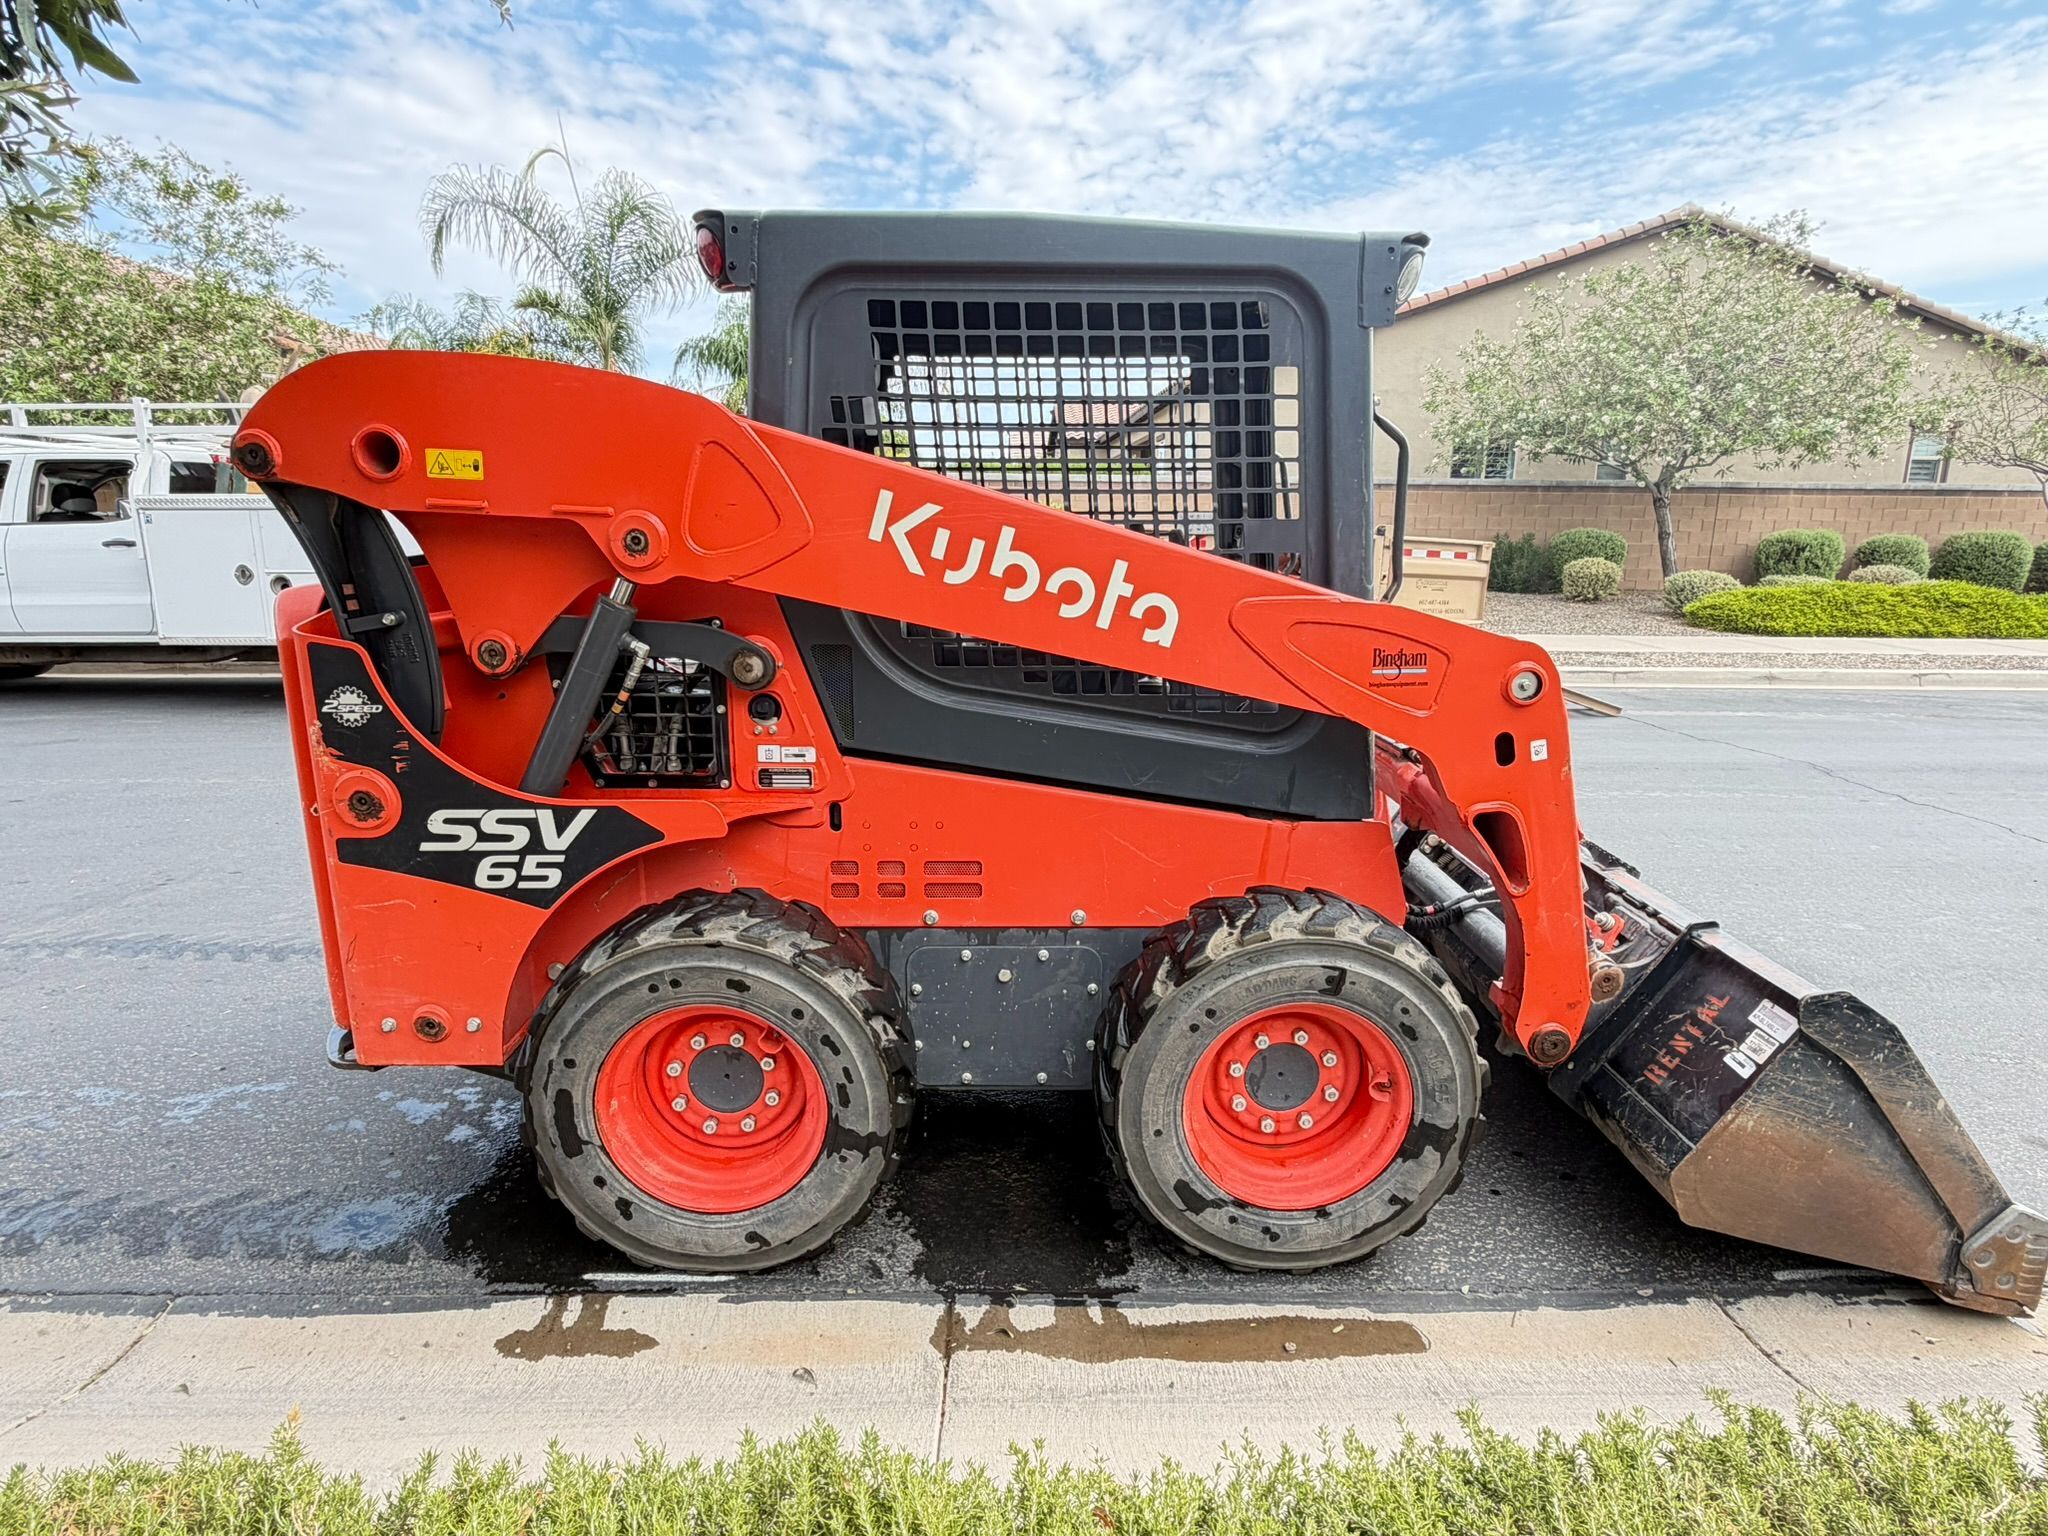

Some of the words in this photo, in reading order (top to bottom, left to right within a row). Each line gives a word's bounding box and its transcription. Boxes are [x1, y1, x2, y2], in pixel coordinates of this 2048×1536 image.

[868, 488, 1179, 649] Kubota
[1372, 647, 1428, 681] Bingham
[418, 808, 599, 852] SSV
[474, 854, 567, 890] 65
[1642, 994, 1732, 1086] RENTAL
